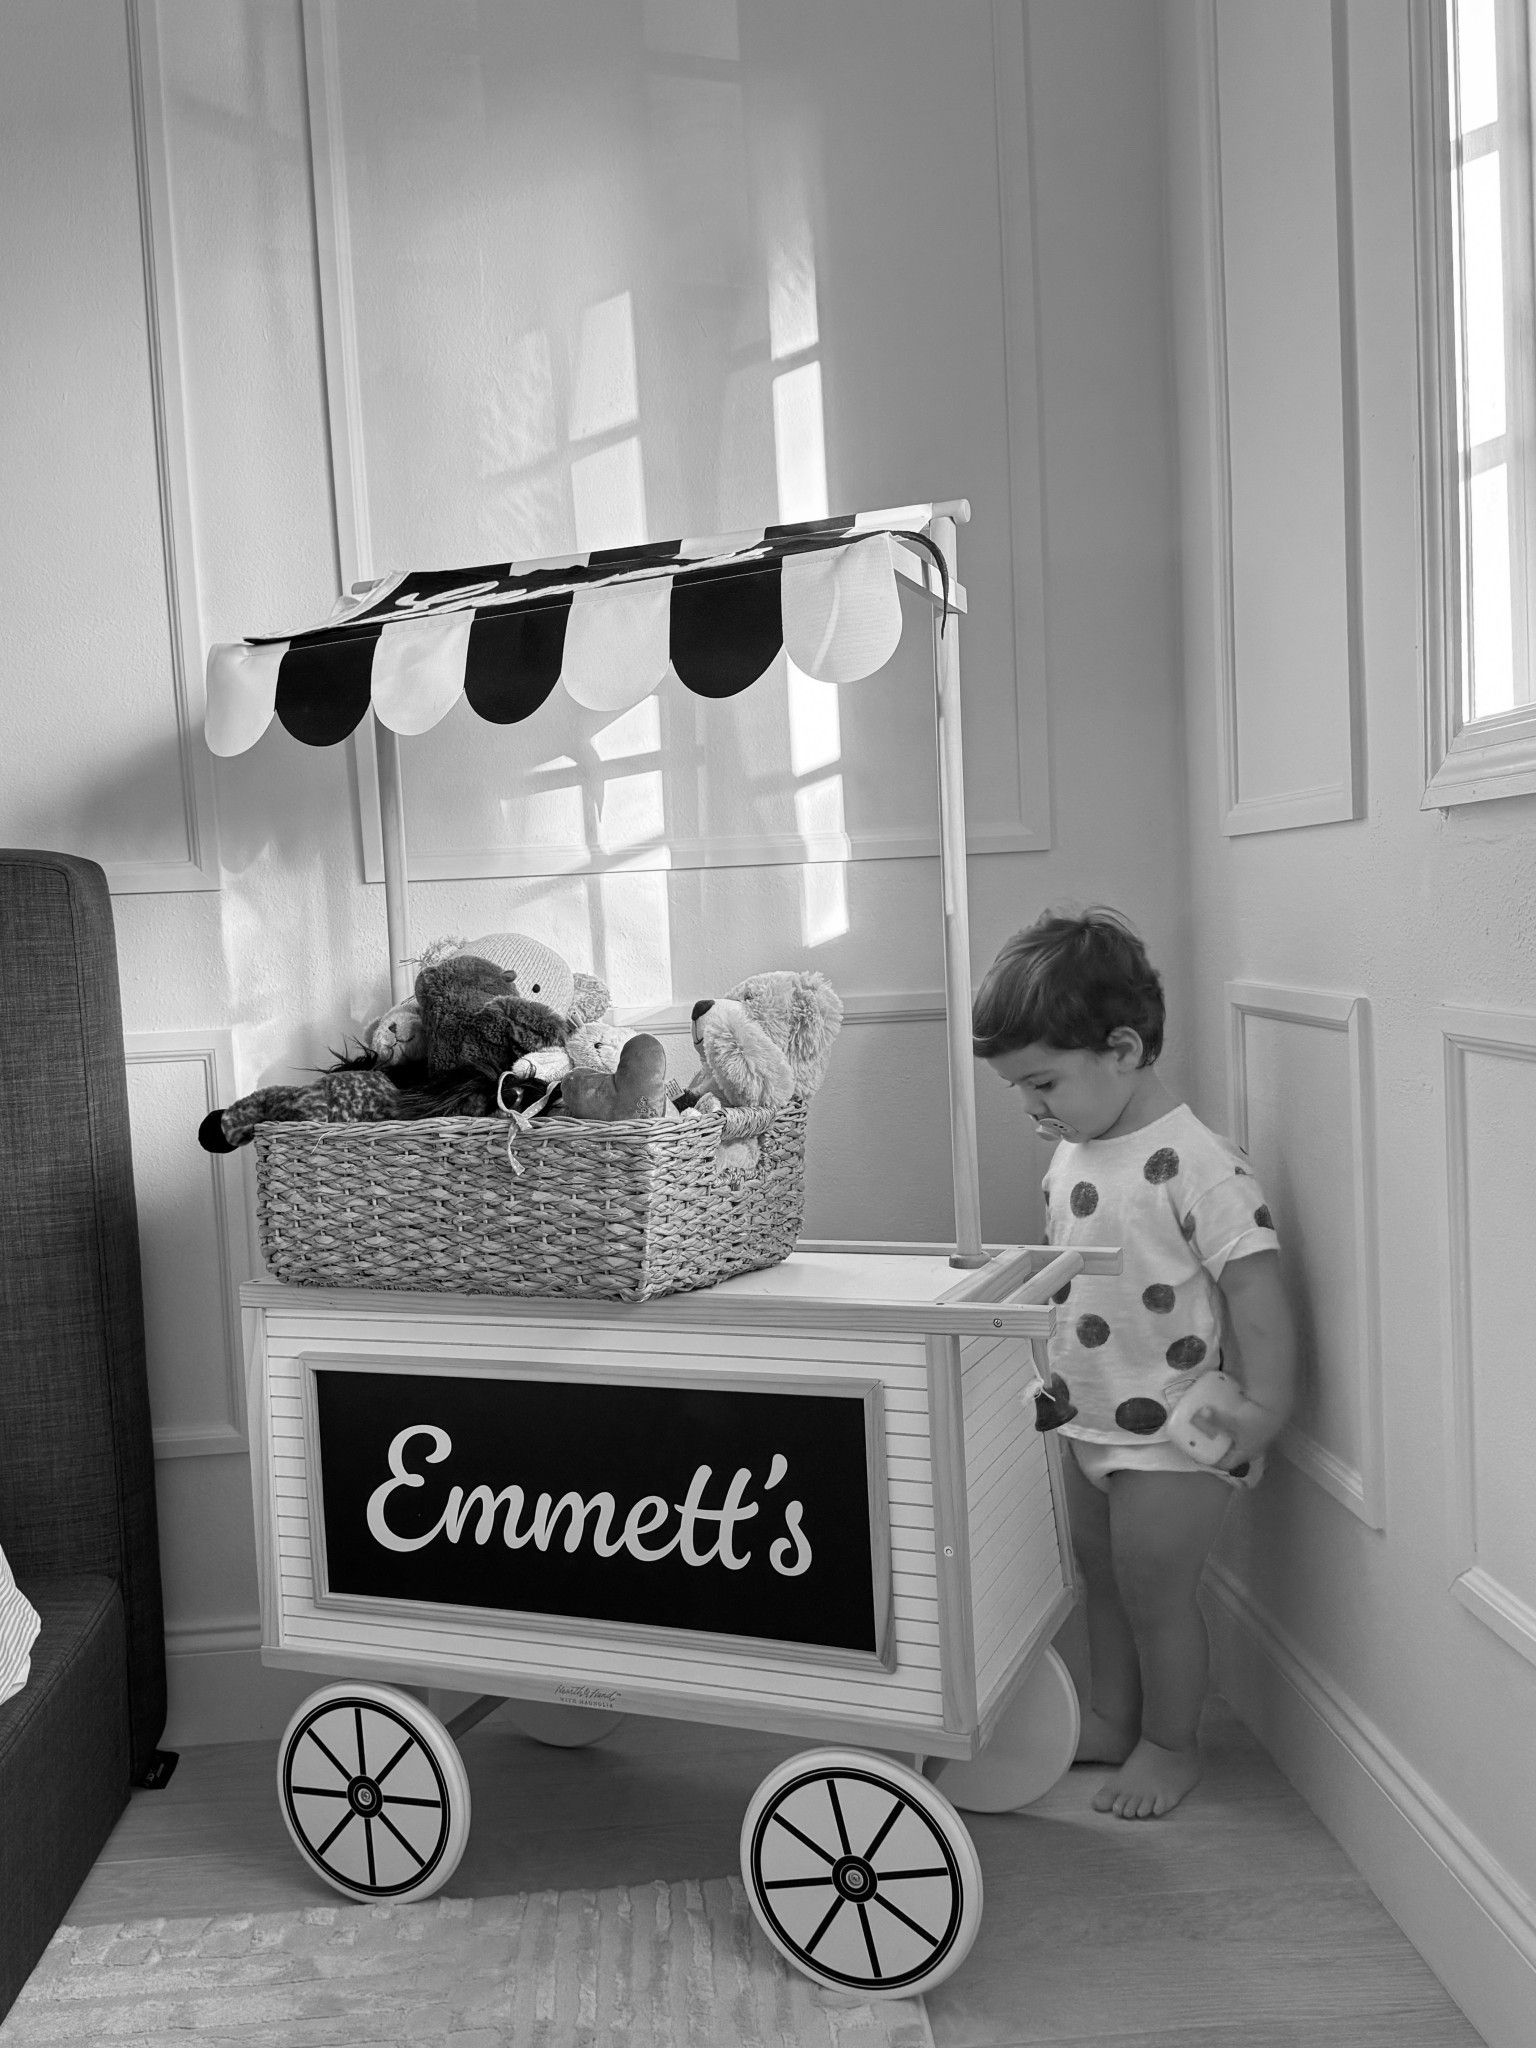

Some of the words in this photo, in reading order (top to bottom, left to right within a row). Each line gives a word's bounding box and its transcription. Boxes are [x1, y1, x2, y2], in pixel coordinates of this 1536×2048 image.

[366, 1424, 813, 1577] Emmett's
[554, 1684, 585, 1698] Hearth
[579, 1699, 613, 1708] MAGNOLIA
